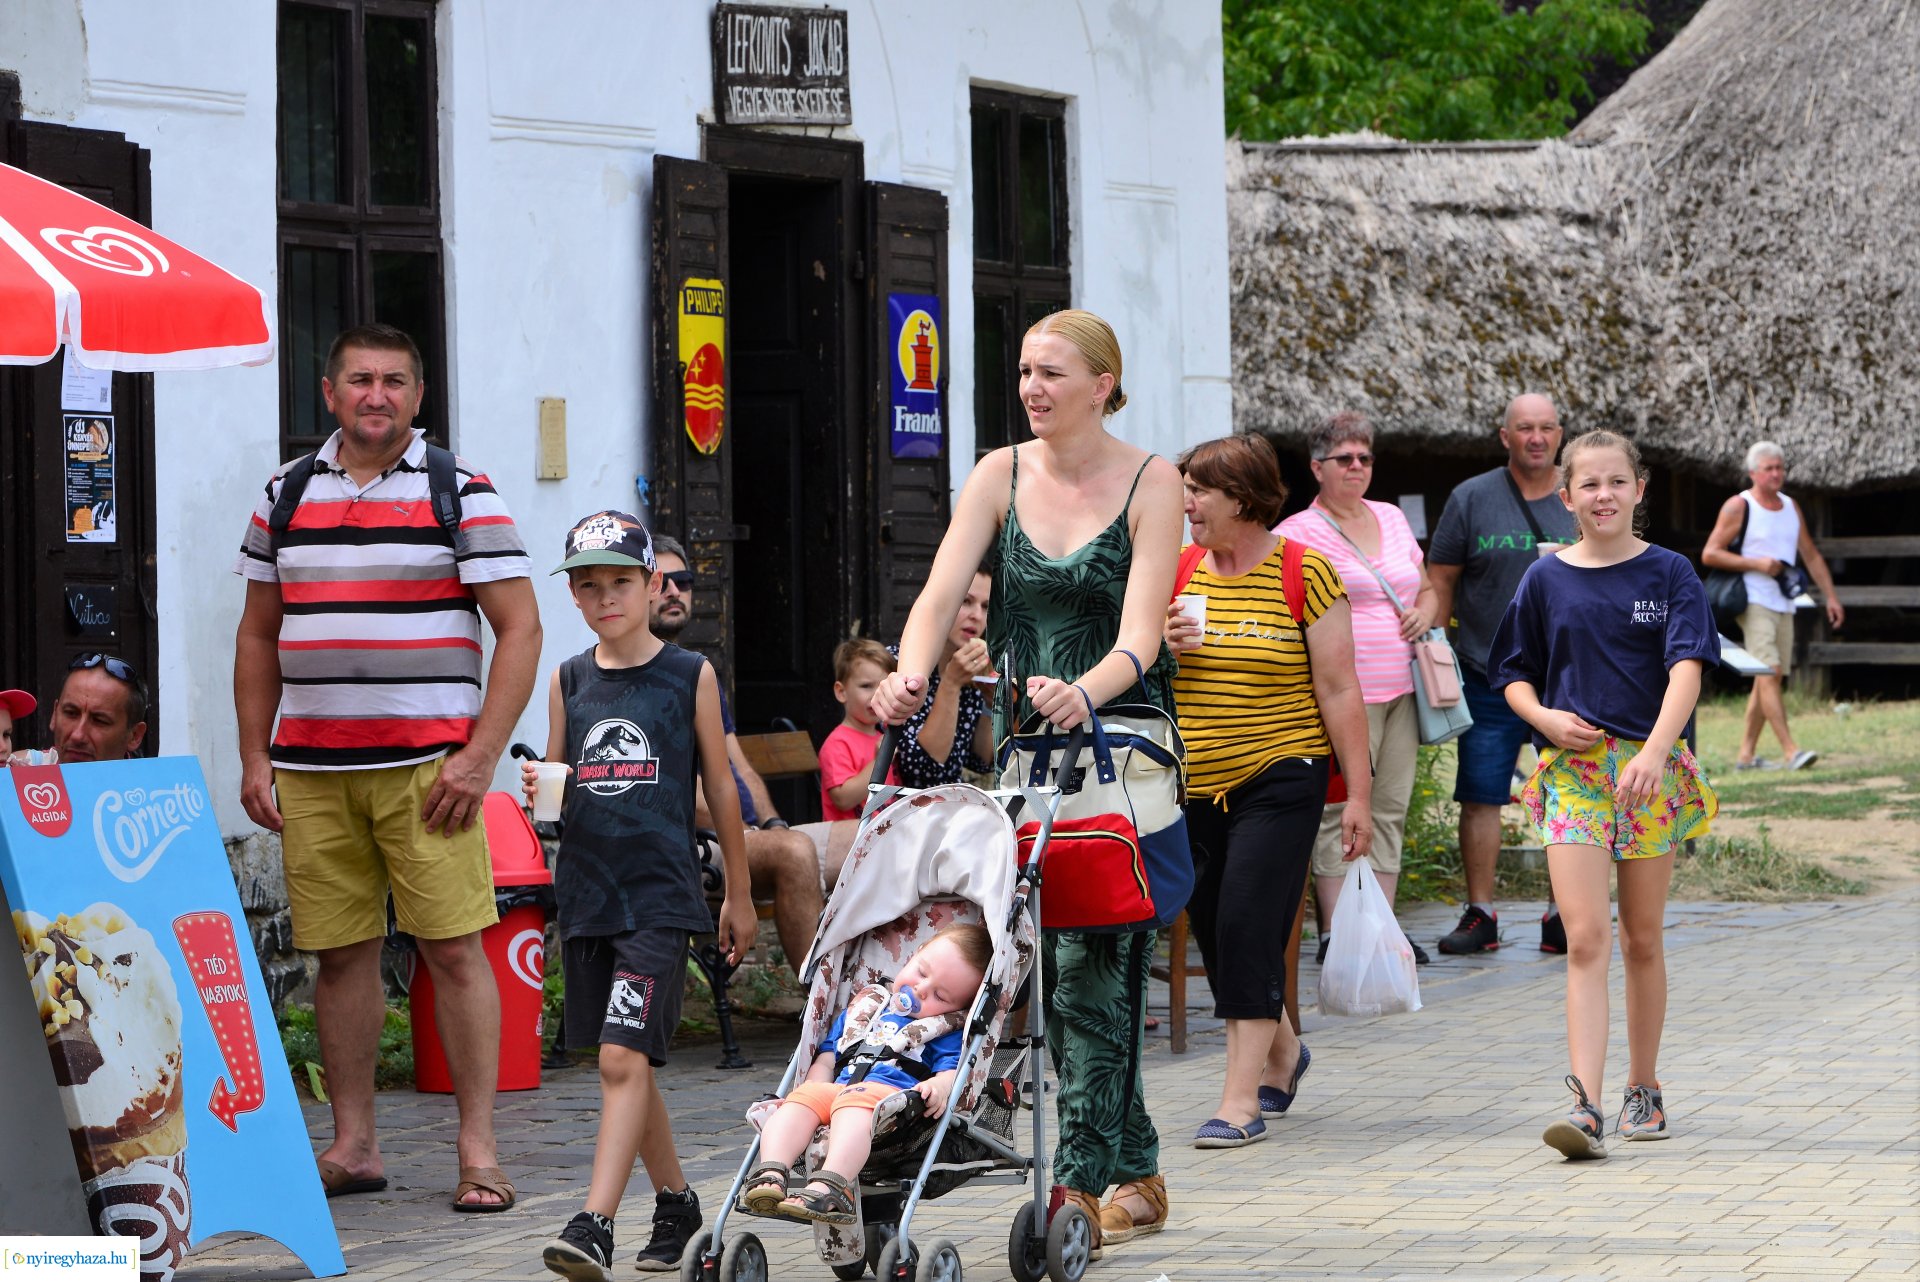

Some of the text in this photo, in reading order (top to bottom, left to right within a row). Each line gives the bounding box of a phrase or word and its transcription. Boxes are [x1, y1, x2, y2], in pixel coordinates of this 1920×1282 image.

[727, 14, 844, 76] LEFKOVITS JAKAB
[728, 79, 847, 119] VEGYESKERESKEDÉSE
[686, 289, 723, 315] PHILIPS
[613, 762, 655, 778] WORLD
[31, 810, 67, 824] ALGIDA
[93, 783, 204, 883] Cornetto
[203, 953, 227, 976] TIÉD
[200, 983, 247, 1005] VAGYOK!
[623, 1017, 646, 1030] WORLD
